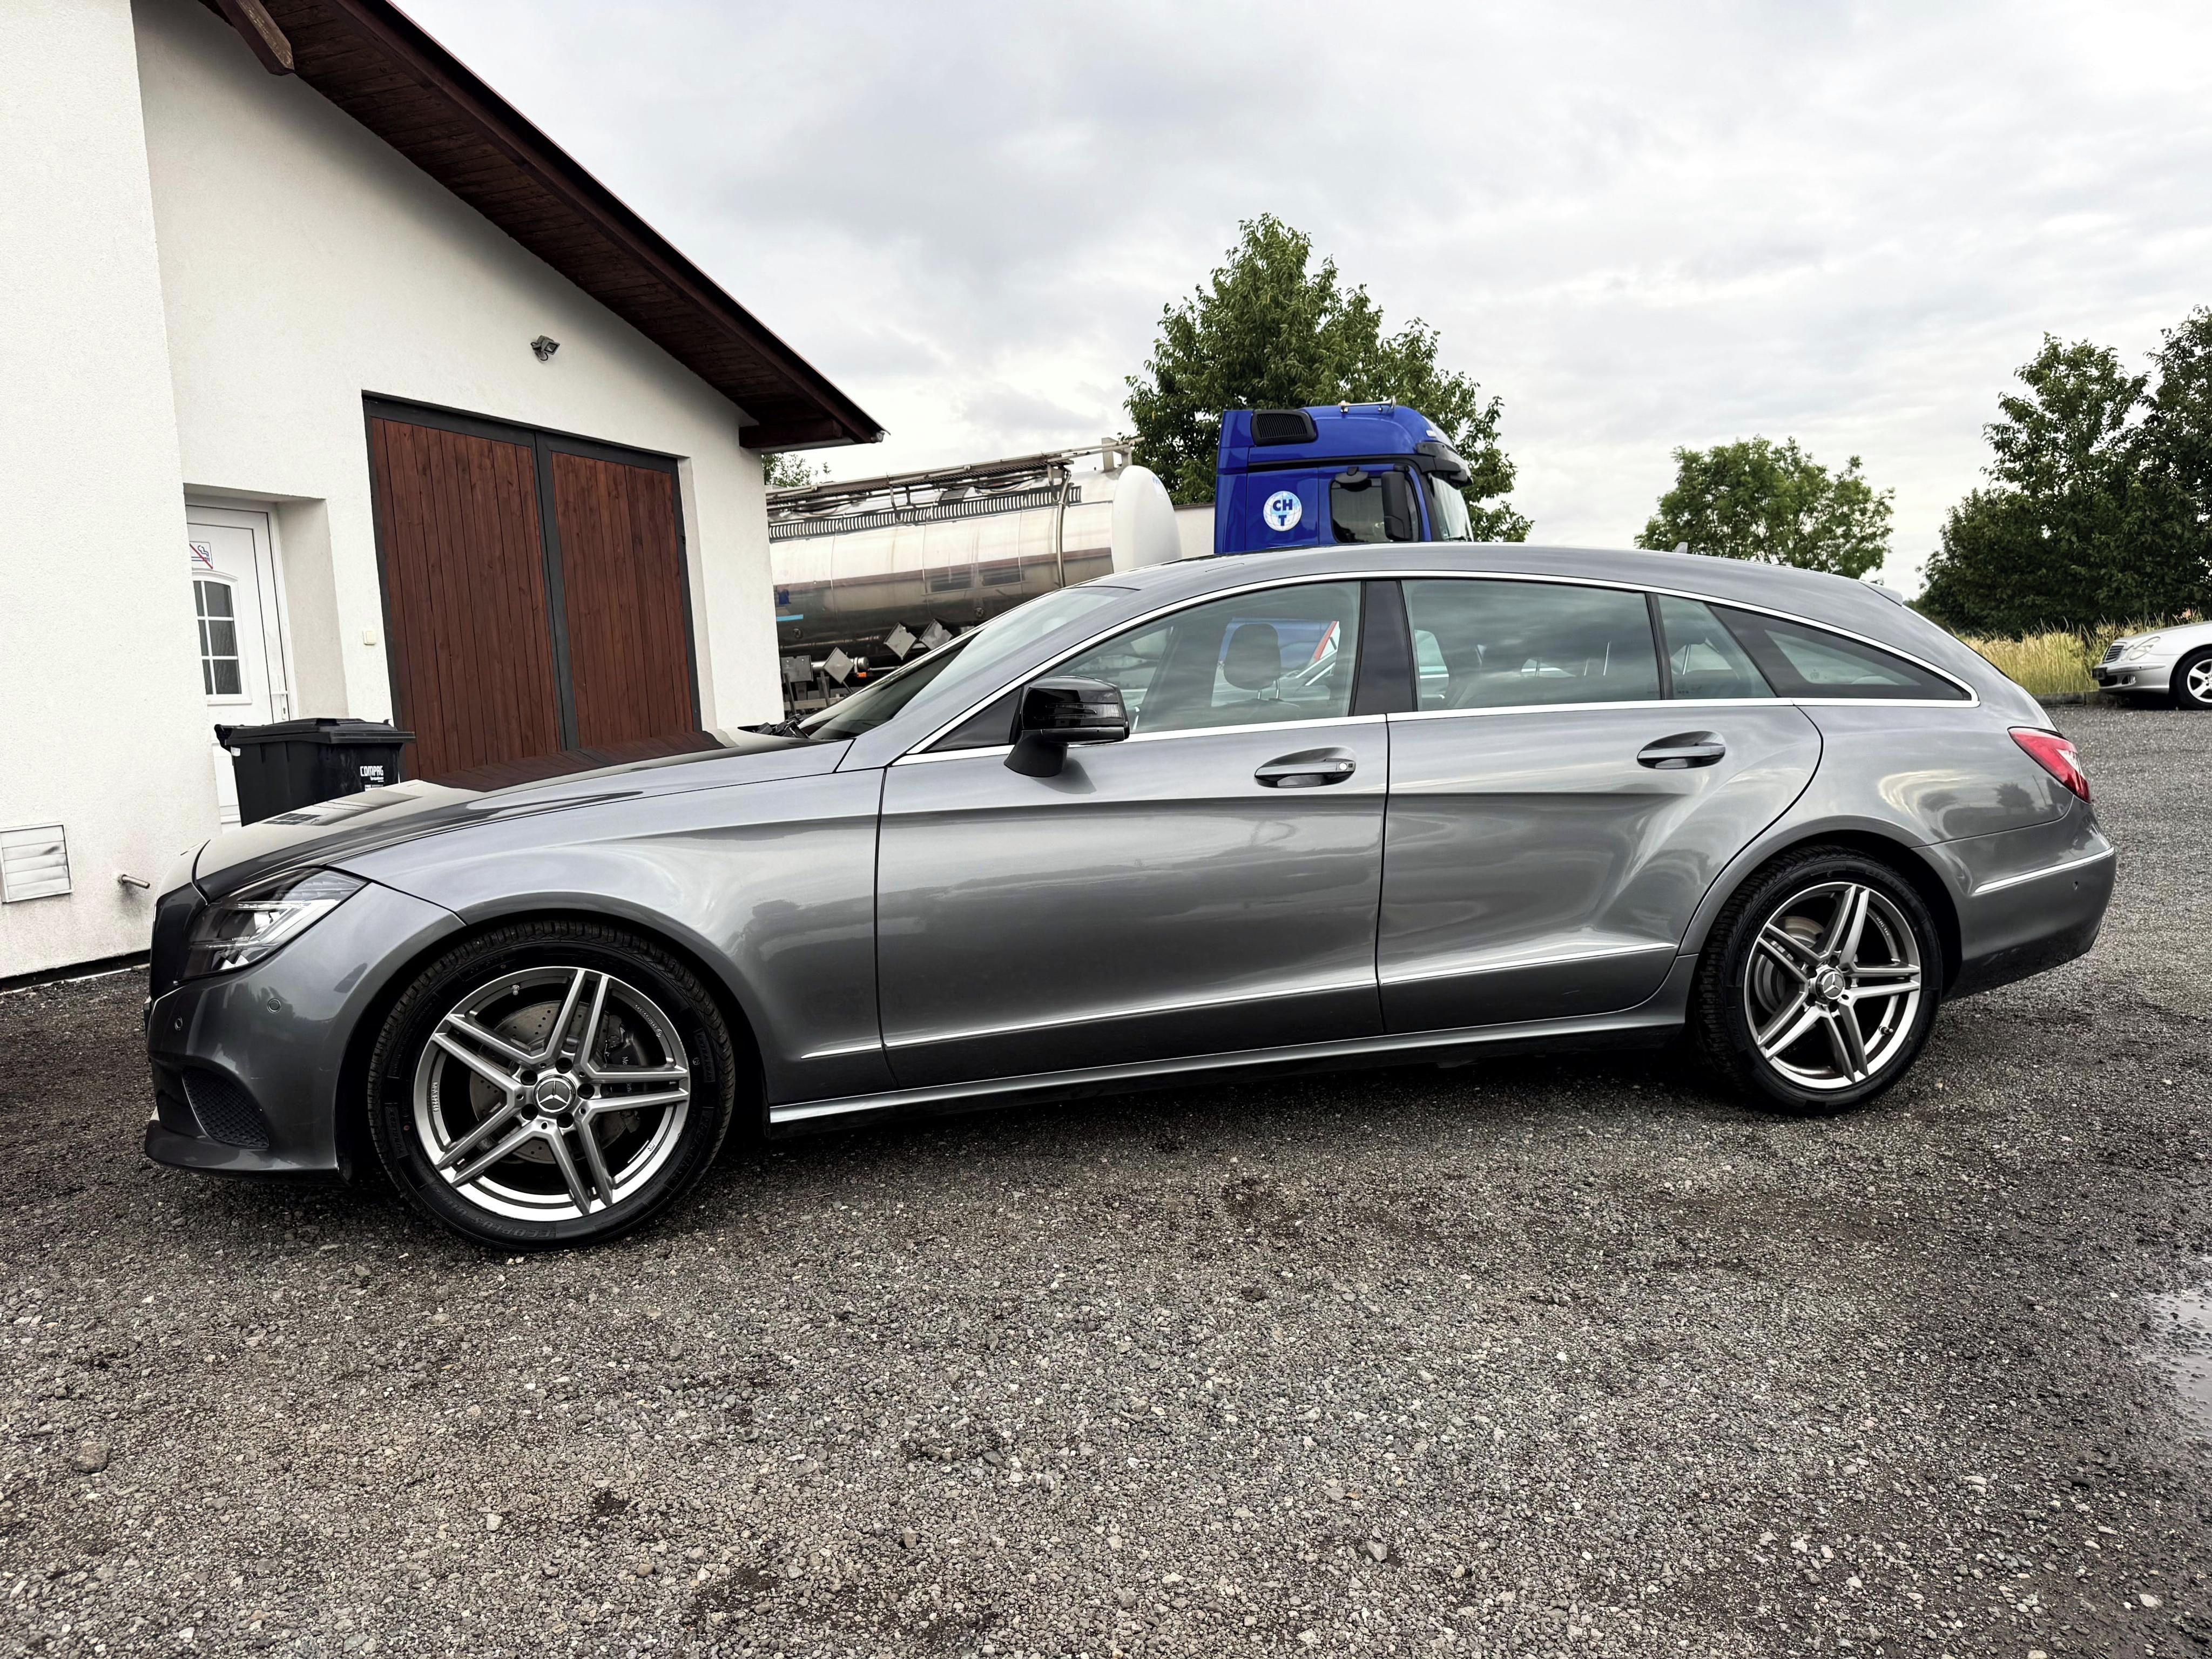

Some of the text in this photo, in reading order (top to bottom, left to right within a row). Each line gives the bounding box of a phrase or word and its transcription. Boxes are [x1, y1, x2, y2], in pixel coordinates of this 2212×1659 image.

[1273, 499, 1293, 511] CH
[1278, 515, 1287, 526] T
[360, 765, 383, 777] COMPAG
